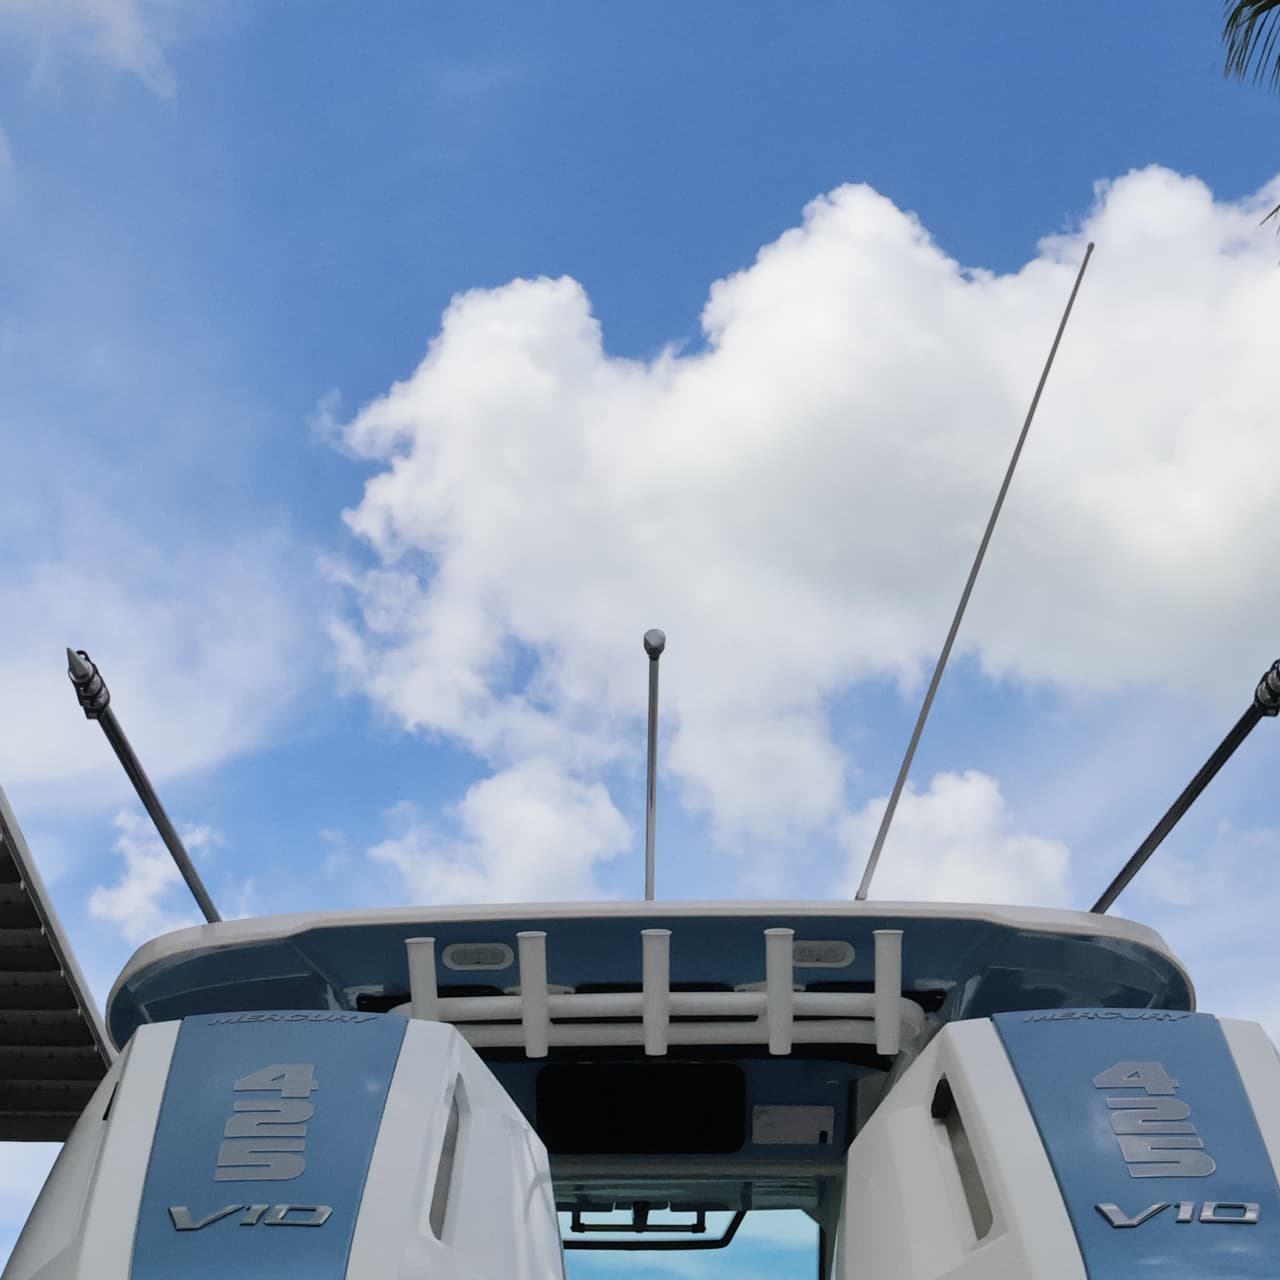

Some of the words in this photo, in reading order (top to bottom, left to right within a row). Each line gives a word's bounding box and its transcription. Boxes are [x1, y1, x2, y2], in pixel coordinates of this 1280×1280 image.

[207, 1012, 379, 1026] MERCURY
[1023, 1010, 1191, 1024] MERCURY
[213, 1063, 320, 1183] 425
[1092, 1061, 1217, 1179] 425
[167, 1203, 334, 1232] V10
[1093, 1200, 1262, 1229] V10
